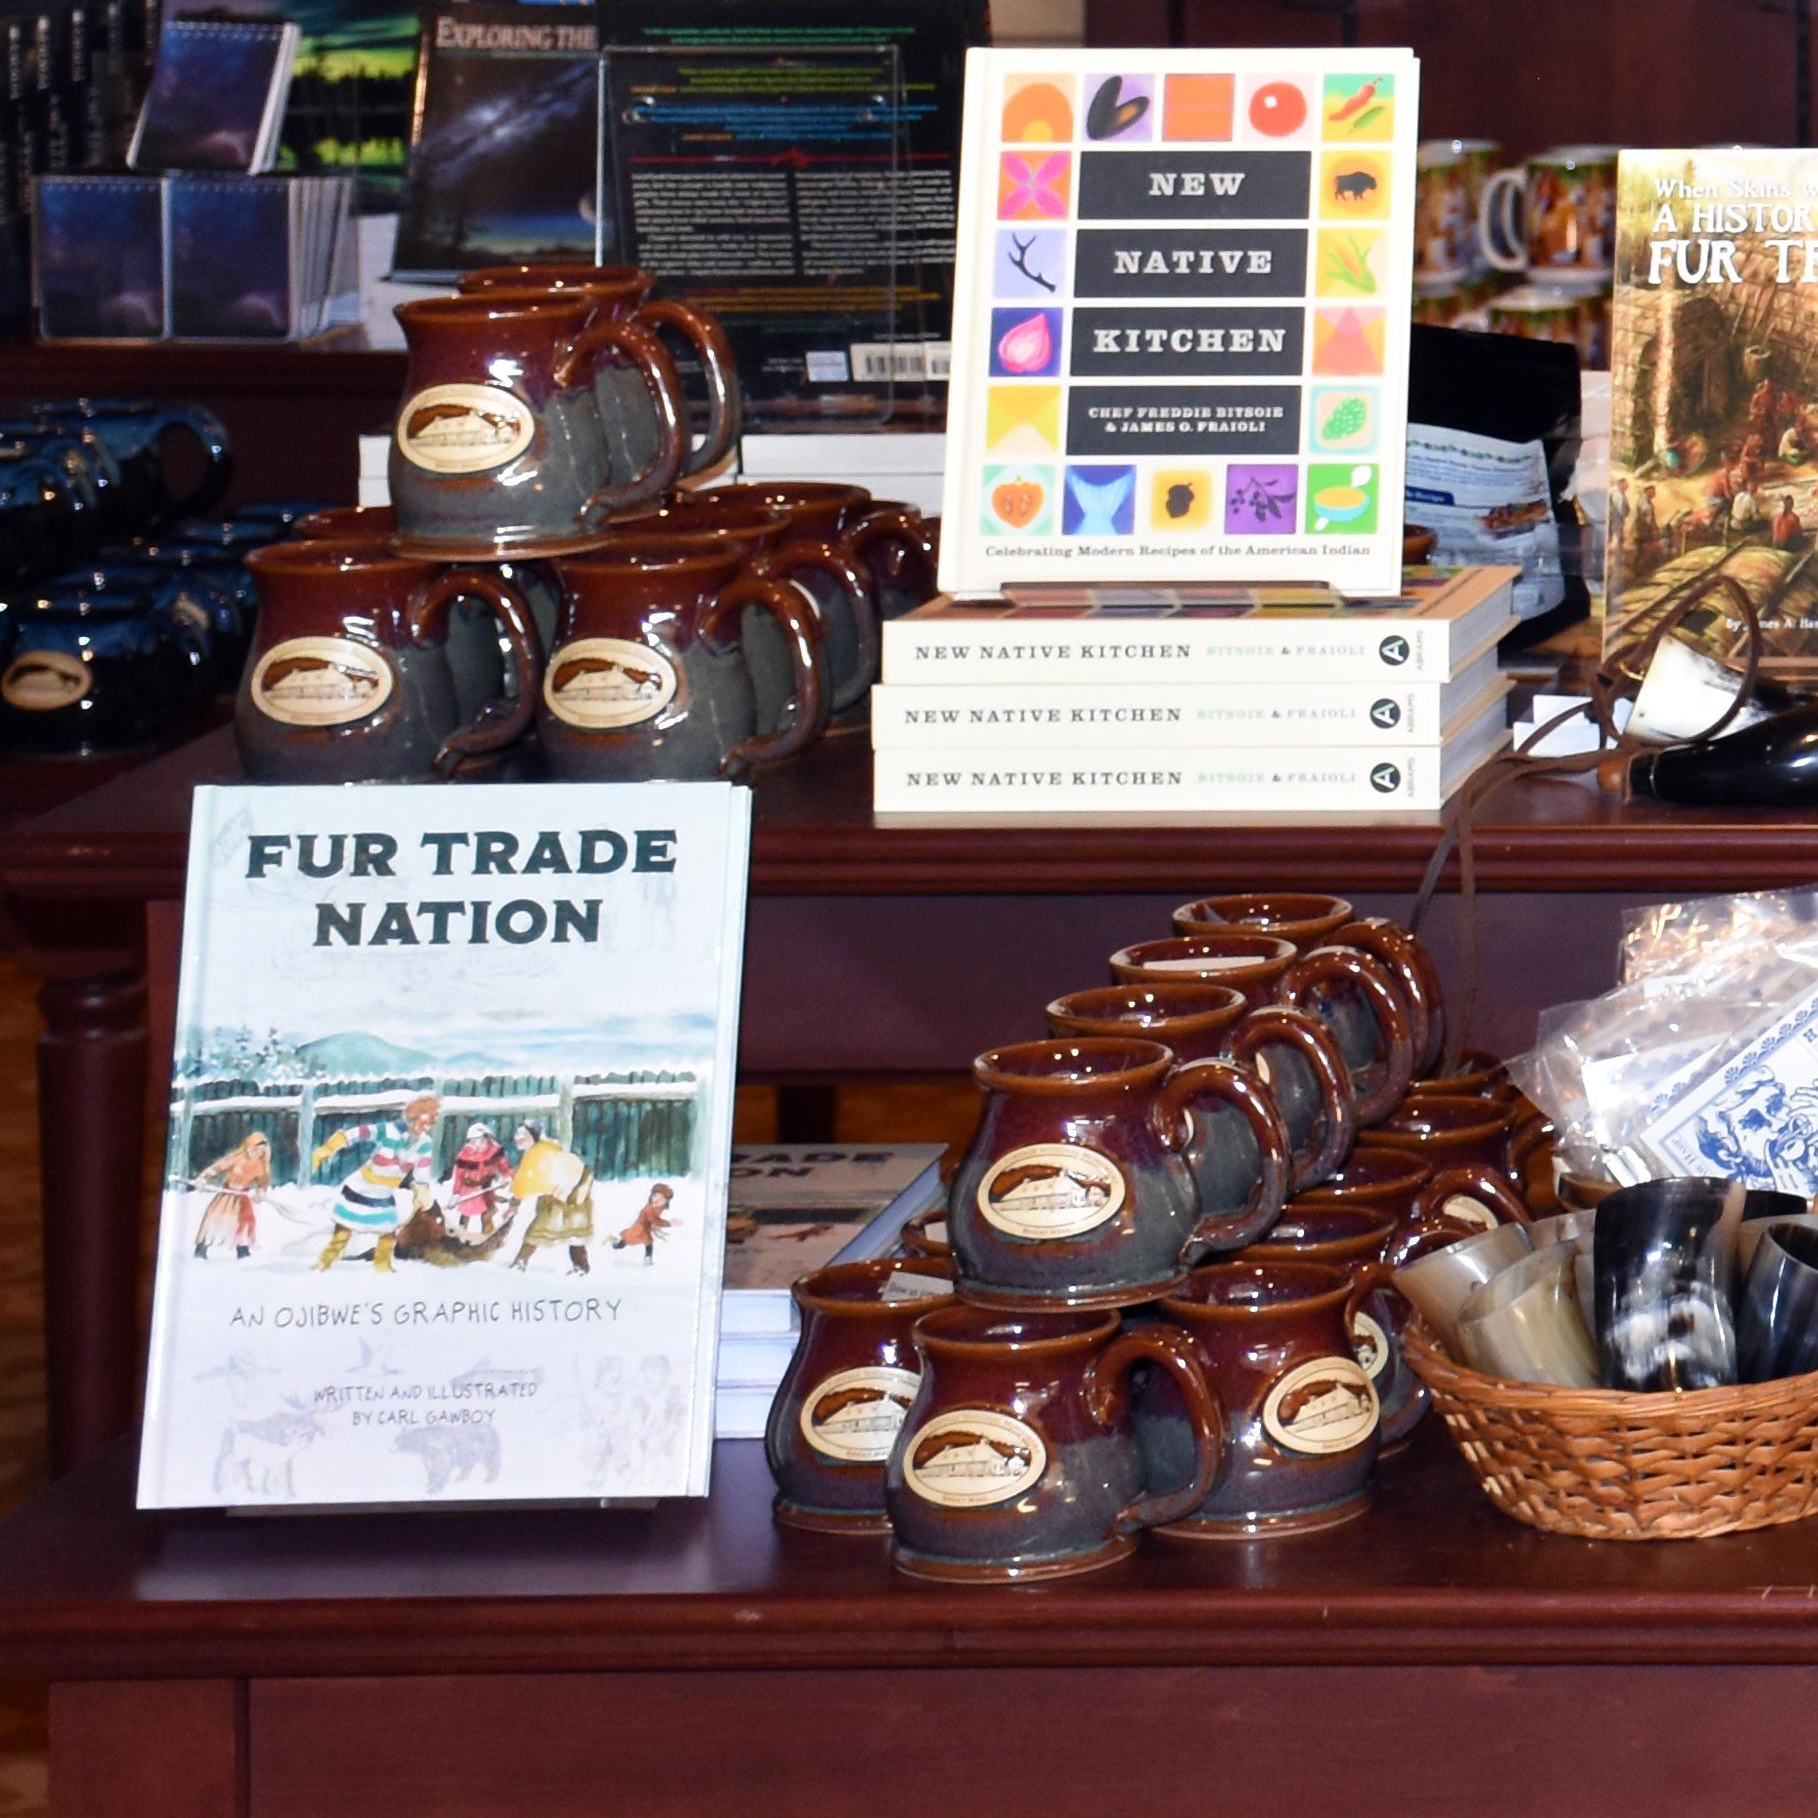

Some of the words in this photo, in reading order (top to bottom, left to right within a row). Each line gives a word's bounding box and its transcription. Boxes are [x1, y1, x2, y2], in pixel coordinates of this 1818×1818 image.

[437, 16, 552, 50] EXPLORING
[557, 25, 598, 50] THE
[1149, 172, 1245, 196] NEW
[1654, 178, 1718, 199] When
[1735, 178, 1791, 198] Skins
[1652, 204, 1678, 233] A
[1114, 250, 1272, 274] NATIVE
[1648, 238, 1743, 285] FUR
[1093, 329, 1286, 353] KITCHEN
[1088, 407, 1133, 419] CHEF
[1137, 407, 1212, 419] FREDDIE
[1105, 422, 1117, 433] &
[1120, 421, 1176, 433] JAMES
[1179, 421, 1194, 433] O.
[1197, 421, 1267, 432] FRAIOLI
[985, 545, 1072, 558] Celebrating
[1078, 545, 1134, 556] Modern
[1139, 545, 1196, 558] Recipes
[1200, 544, 1215, 556] of
[1218, 544, 1241, 556] the
[1244, 544, 1317, 556] American
[1322, 544, 1371, 556] Indian
[916, 646, 970, 660] NEW
[980, 646, 1071, 660] NATIVE
[1081, 644, 1192, 659] KITCHEN
[1281, 646, 1291, 656] &
[1296, 645, 1365, 655] FRAIOLI
[905, 710, 961, 724] NEW
[970, 709, 1061, 723] NATIVE
[1071, 708, 1182, 722] KITCHEN
[1271, 709, 1281, 719] &
[1287, 709, 1356, 719] FRAIOLI
[907, 772, 962, 787] NEW
[971, 772, 1062, 786] NATIVE
[1072, 771, 1183, 786] KITCHEN
[1272, 772, 1281, 783] &
[1287, 773, 1356, 783] FRAIOLI
[245, 833, 398, 878] FUR
[421, 829, 677, 875] TRADE
[313, 899, 603, 946] NATION
[230, 1306, 264, 1329] AN
[275, 1303, 383, 1328] OJIBWE'S
[395, 1301, 500, 1326] GRAPHIC
[512, 1298, 622, 1323] HISTORY
[314, 1385, 384, 1403] WRITTEN
[390, 1385, 421, 1401] AND
[428, 1382, 537, 1401] ILLUSTRATED
[353, 1411, 372, 1426] BY
[377, 1410, 418, 1426] CARL
[425, 1408, 496, 1425] GAWBOY
